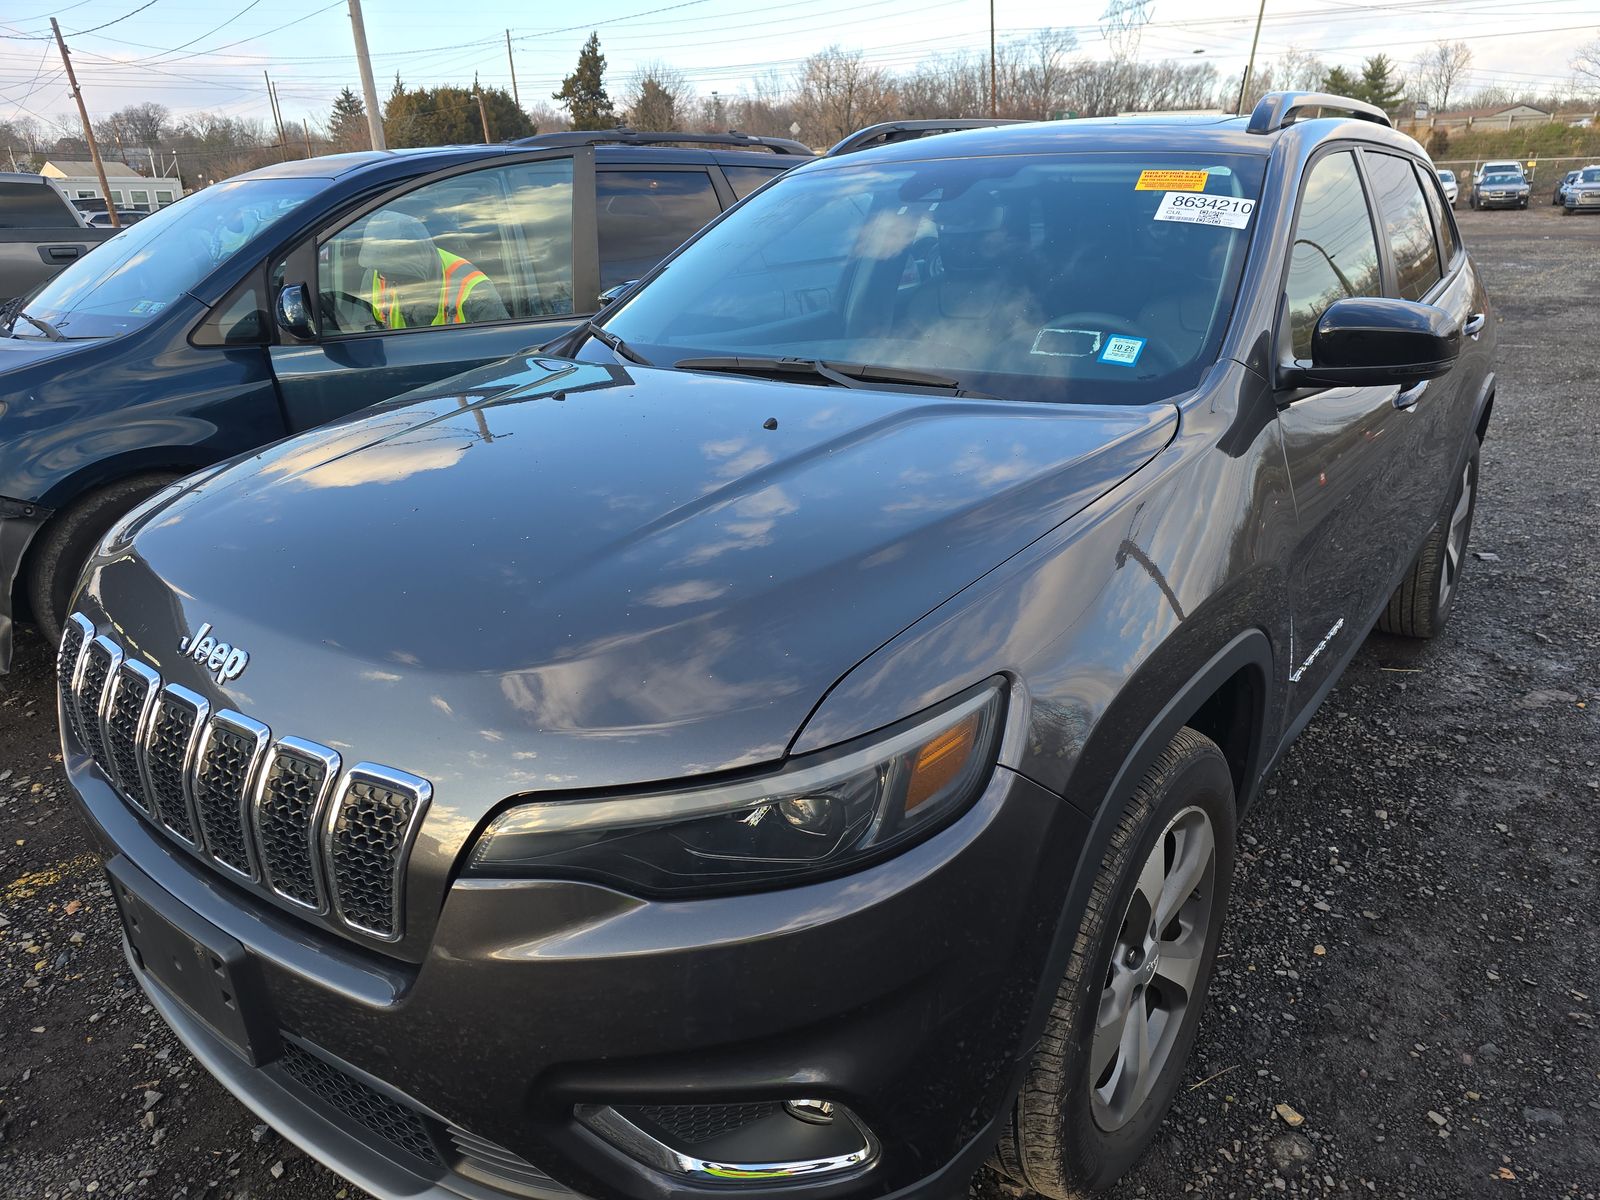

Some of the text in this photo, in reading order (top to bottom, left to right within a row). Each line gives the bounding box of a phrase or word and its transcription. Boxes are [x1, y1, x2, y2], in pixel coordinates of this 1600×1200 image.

[1172, 195, 1253, 214] 8634210
[1124, 345, 1135, 353] 25
[176, 622, 250, 685] Jeep
